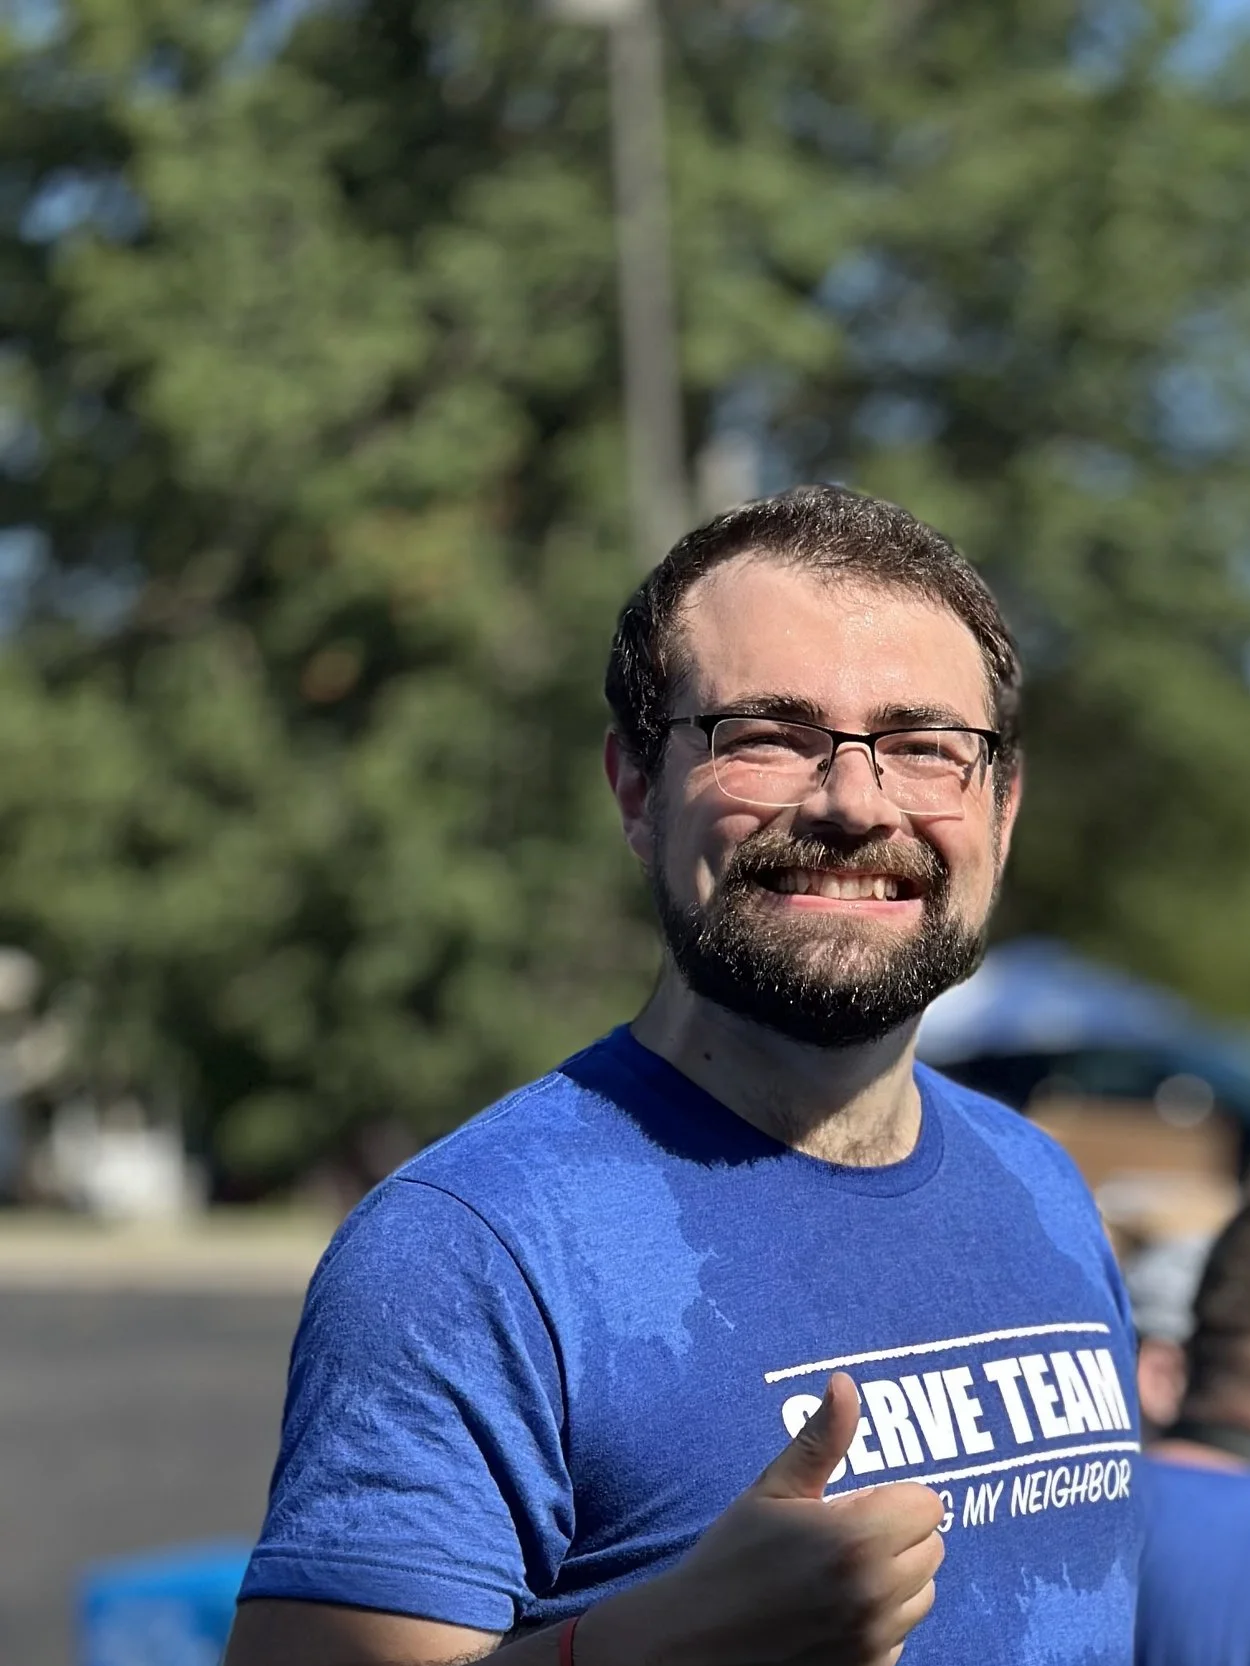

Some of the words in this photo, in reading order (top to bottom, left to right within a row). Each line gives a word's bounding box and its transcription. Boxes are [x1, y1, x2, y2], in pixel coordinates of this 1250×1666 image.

[982, 1349, 1131, 1444] TEAM
[963, 1480, 1004, 1528] MY
[1011, 1458, 1132, 1518] NEIGHBOR
